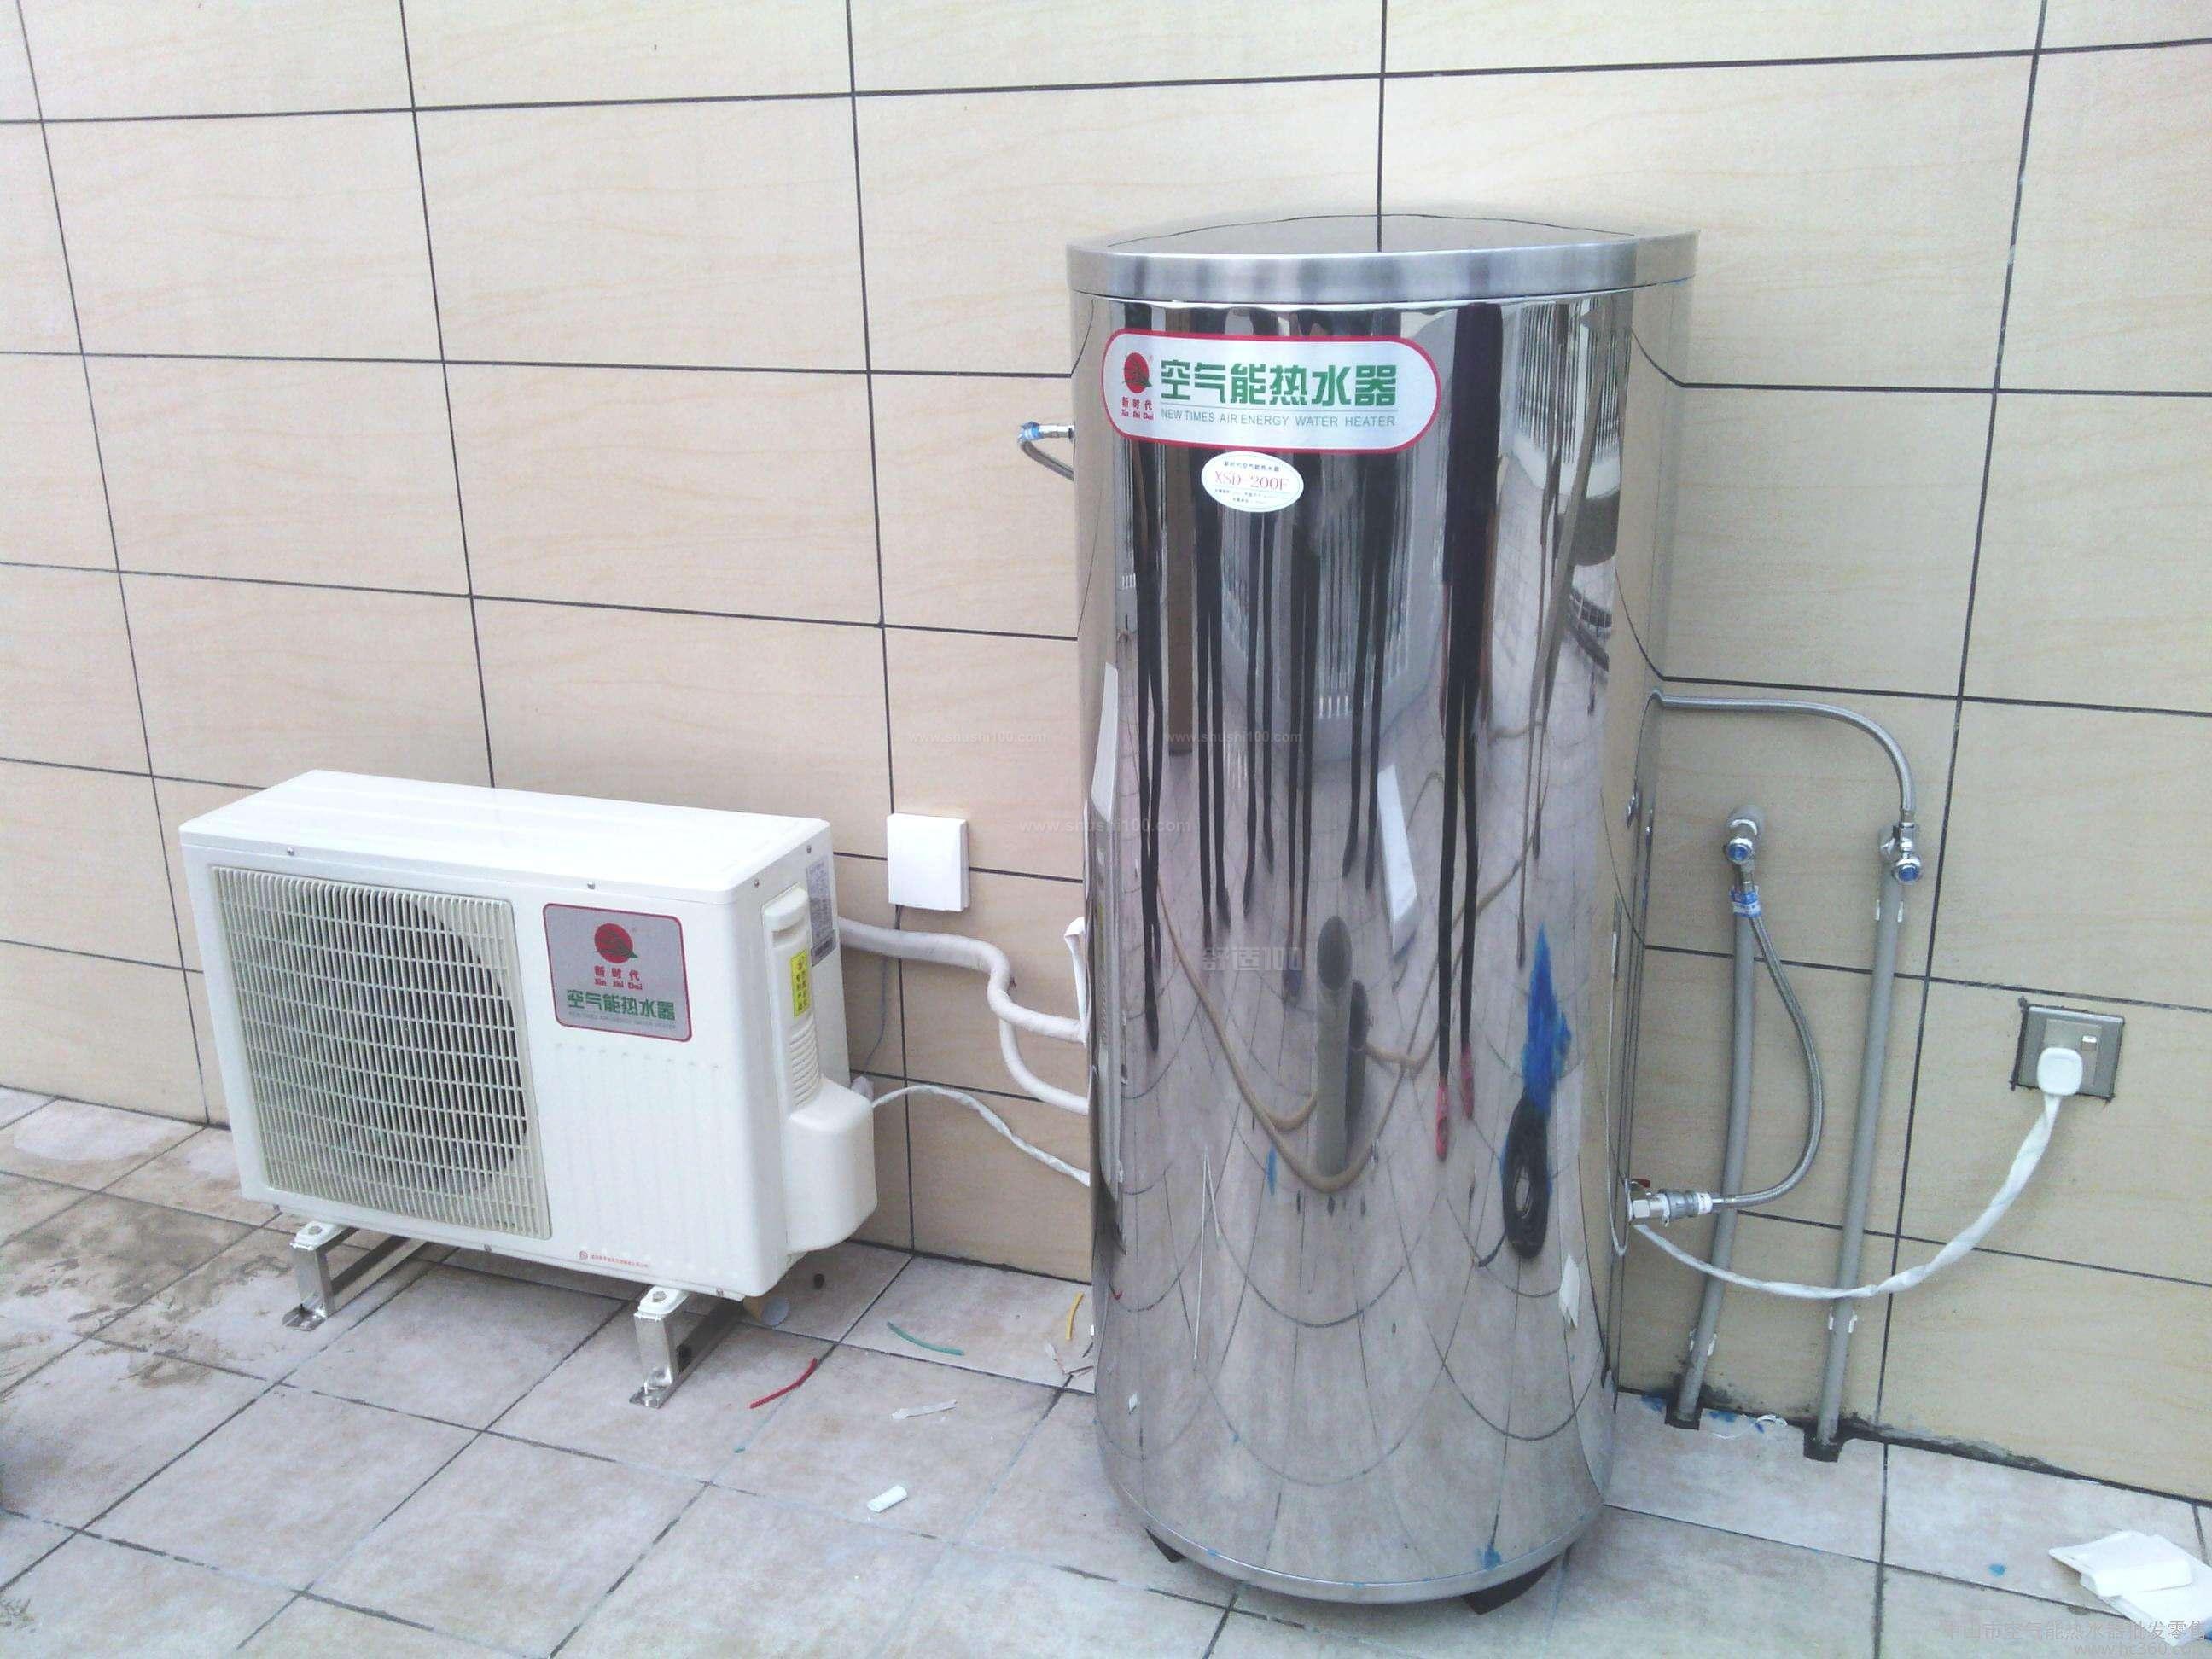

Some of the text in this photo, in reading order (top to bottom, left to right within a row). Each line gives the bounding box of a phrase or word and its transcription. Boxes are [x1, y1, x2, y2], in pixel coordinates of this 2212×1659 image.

[1161, 359, 1397, 406] 空气能热水器
[1121, 396, 1153, 411] 新时代
[1161, 409, 1395, 427] NEW TIMES AIR ENERGY WATER HEATER
[594, 965, 641, 981] 新时代
[567, 989, 676, 1021] 空气能热水器
